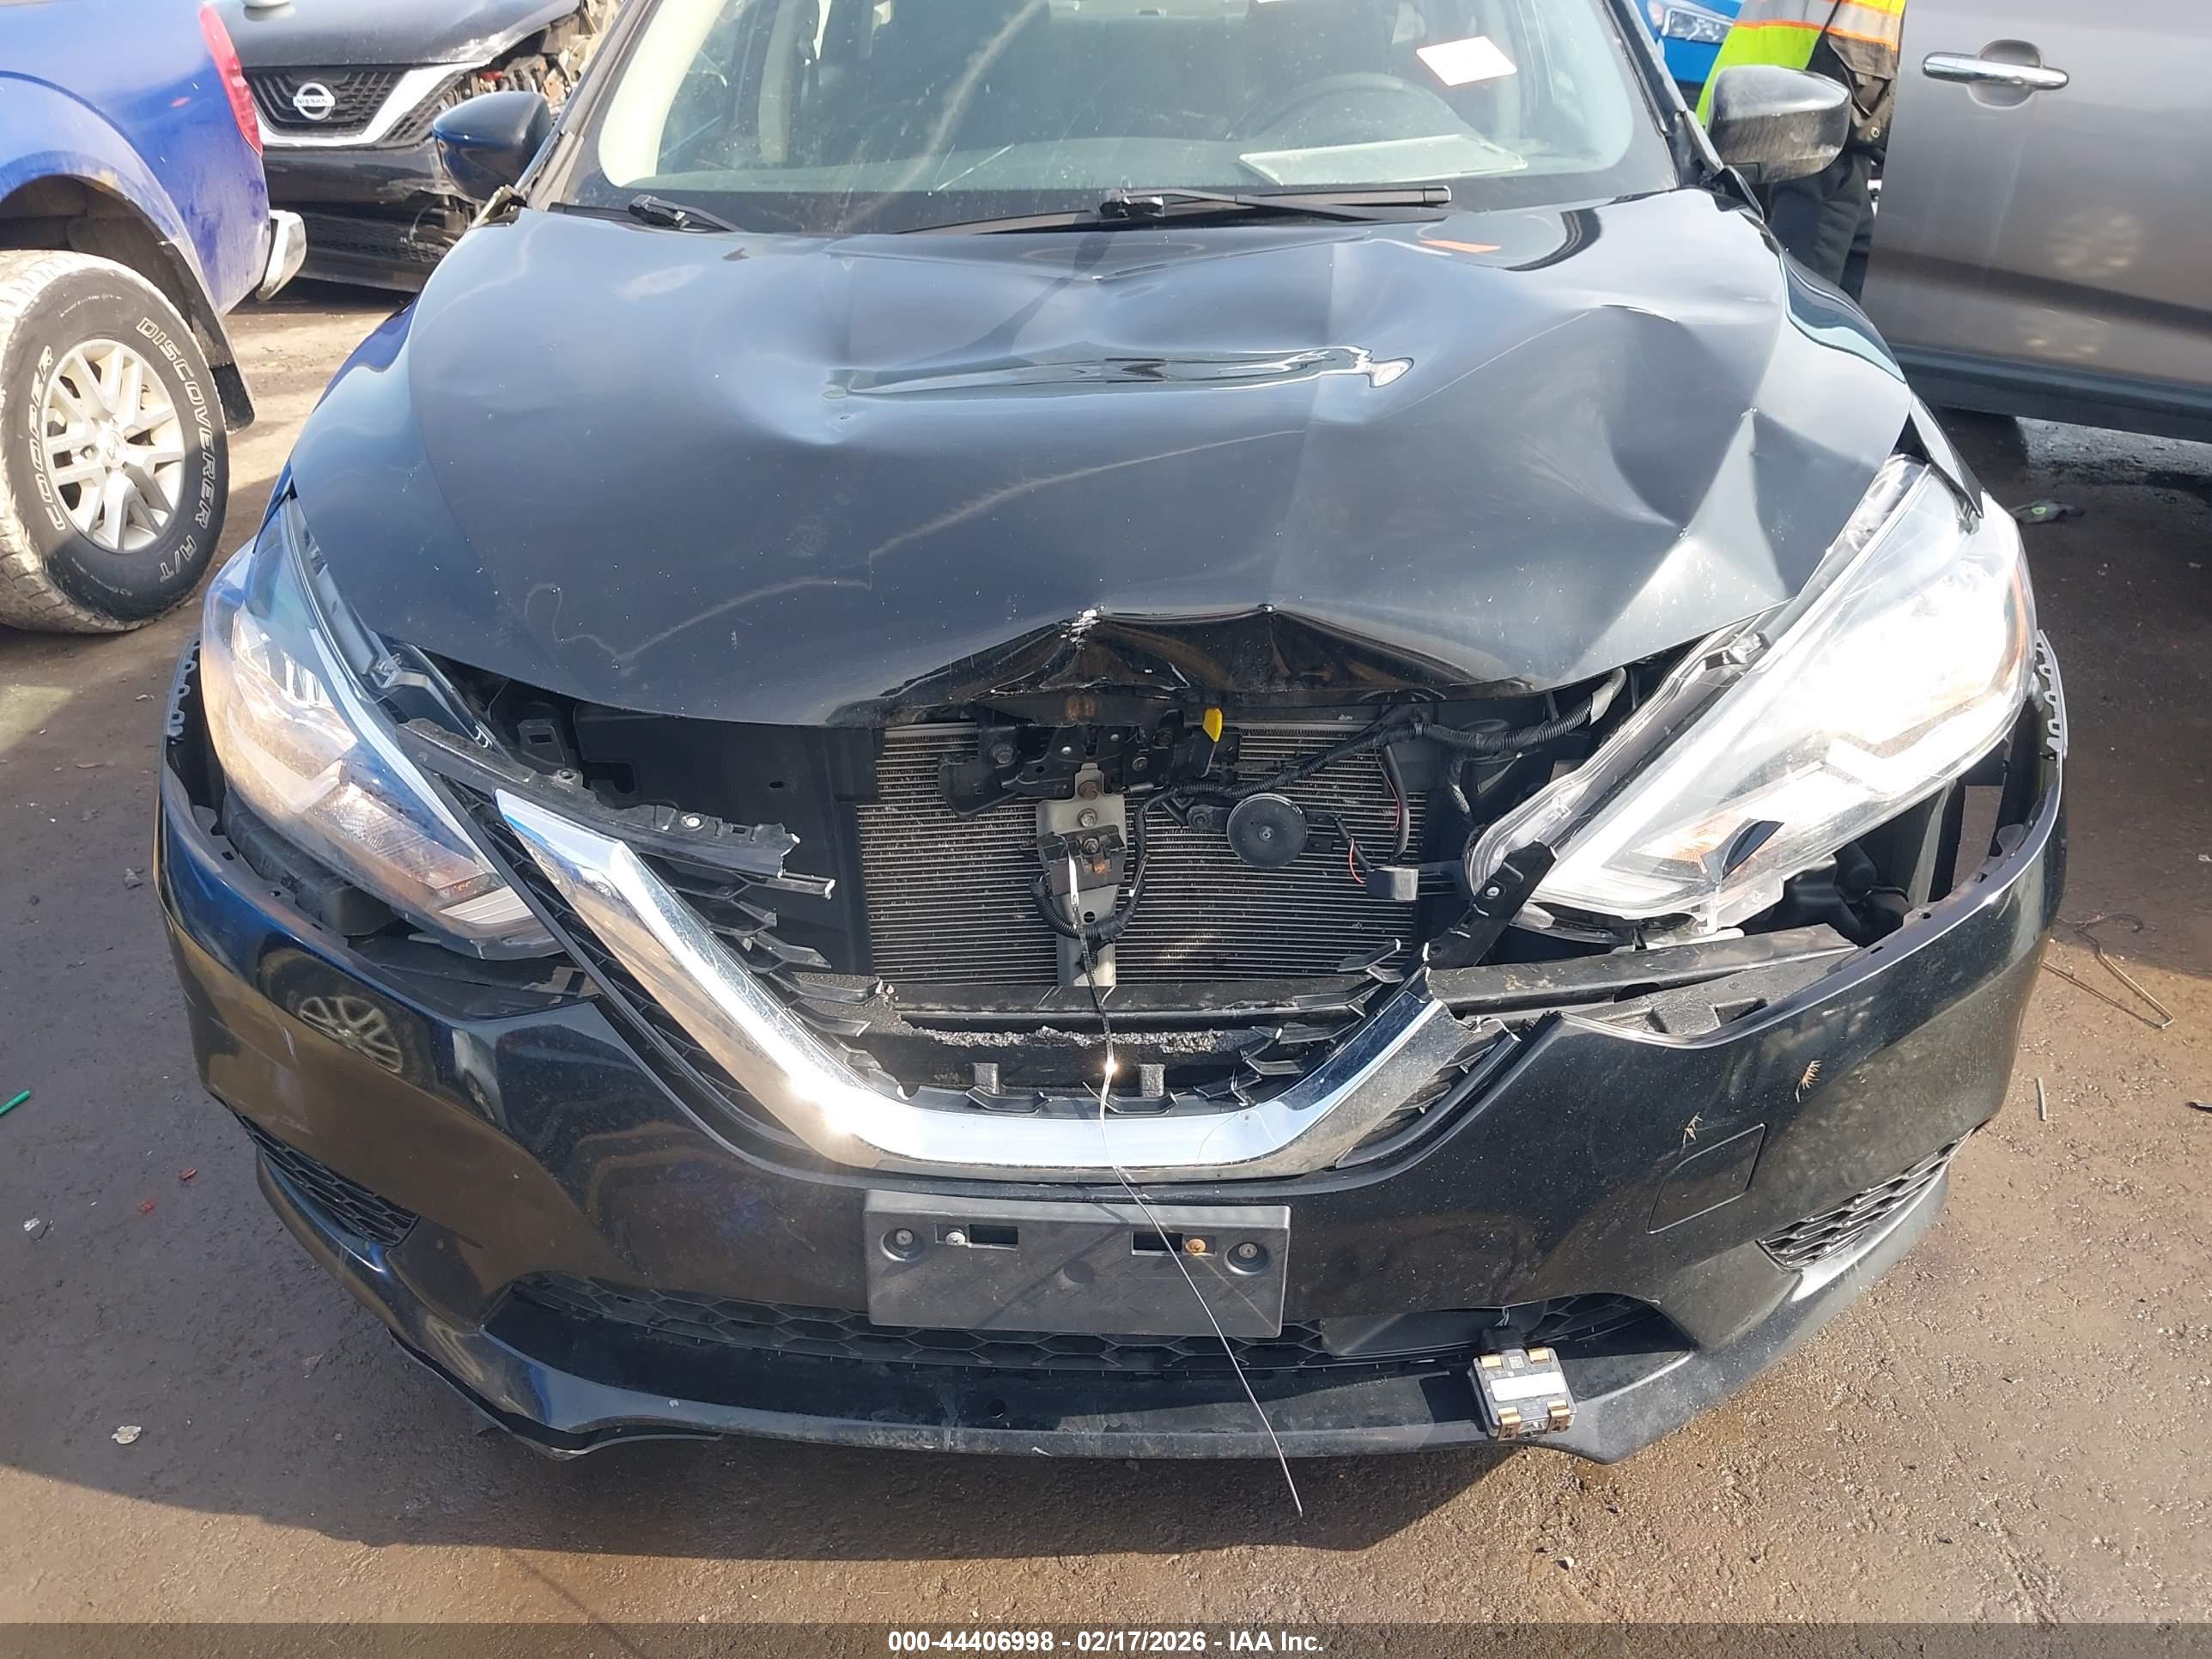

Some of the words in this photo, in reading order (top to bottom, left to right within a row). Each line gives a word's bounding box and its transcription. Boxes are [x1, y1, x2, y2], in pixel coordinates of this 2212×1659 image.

[28, 344, 66, 532] COOPER
[136, 315, 217, 530] DISCOVERER
[160, 537, 198, 583] A/T
